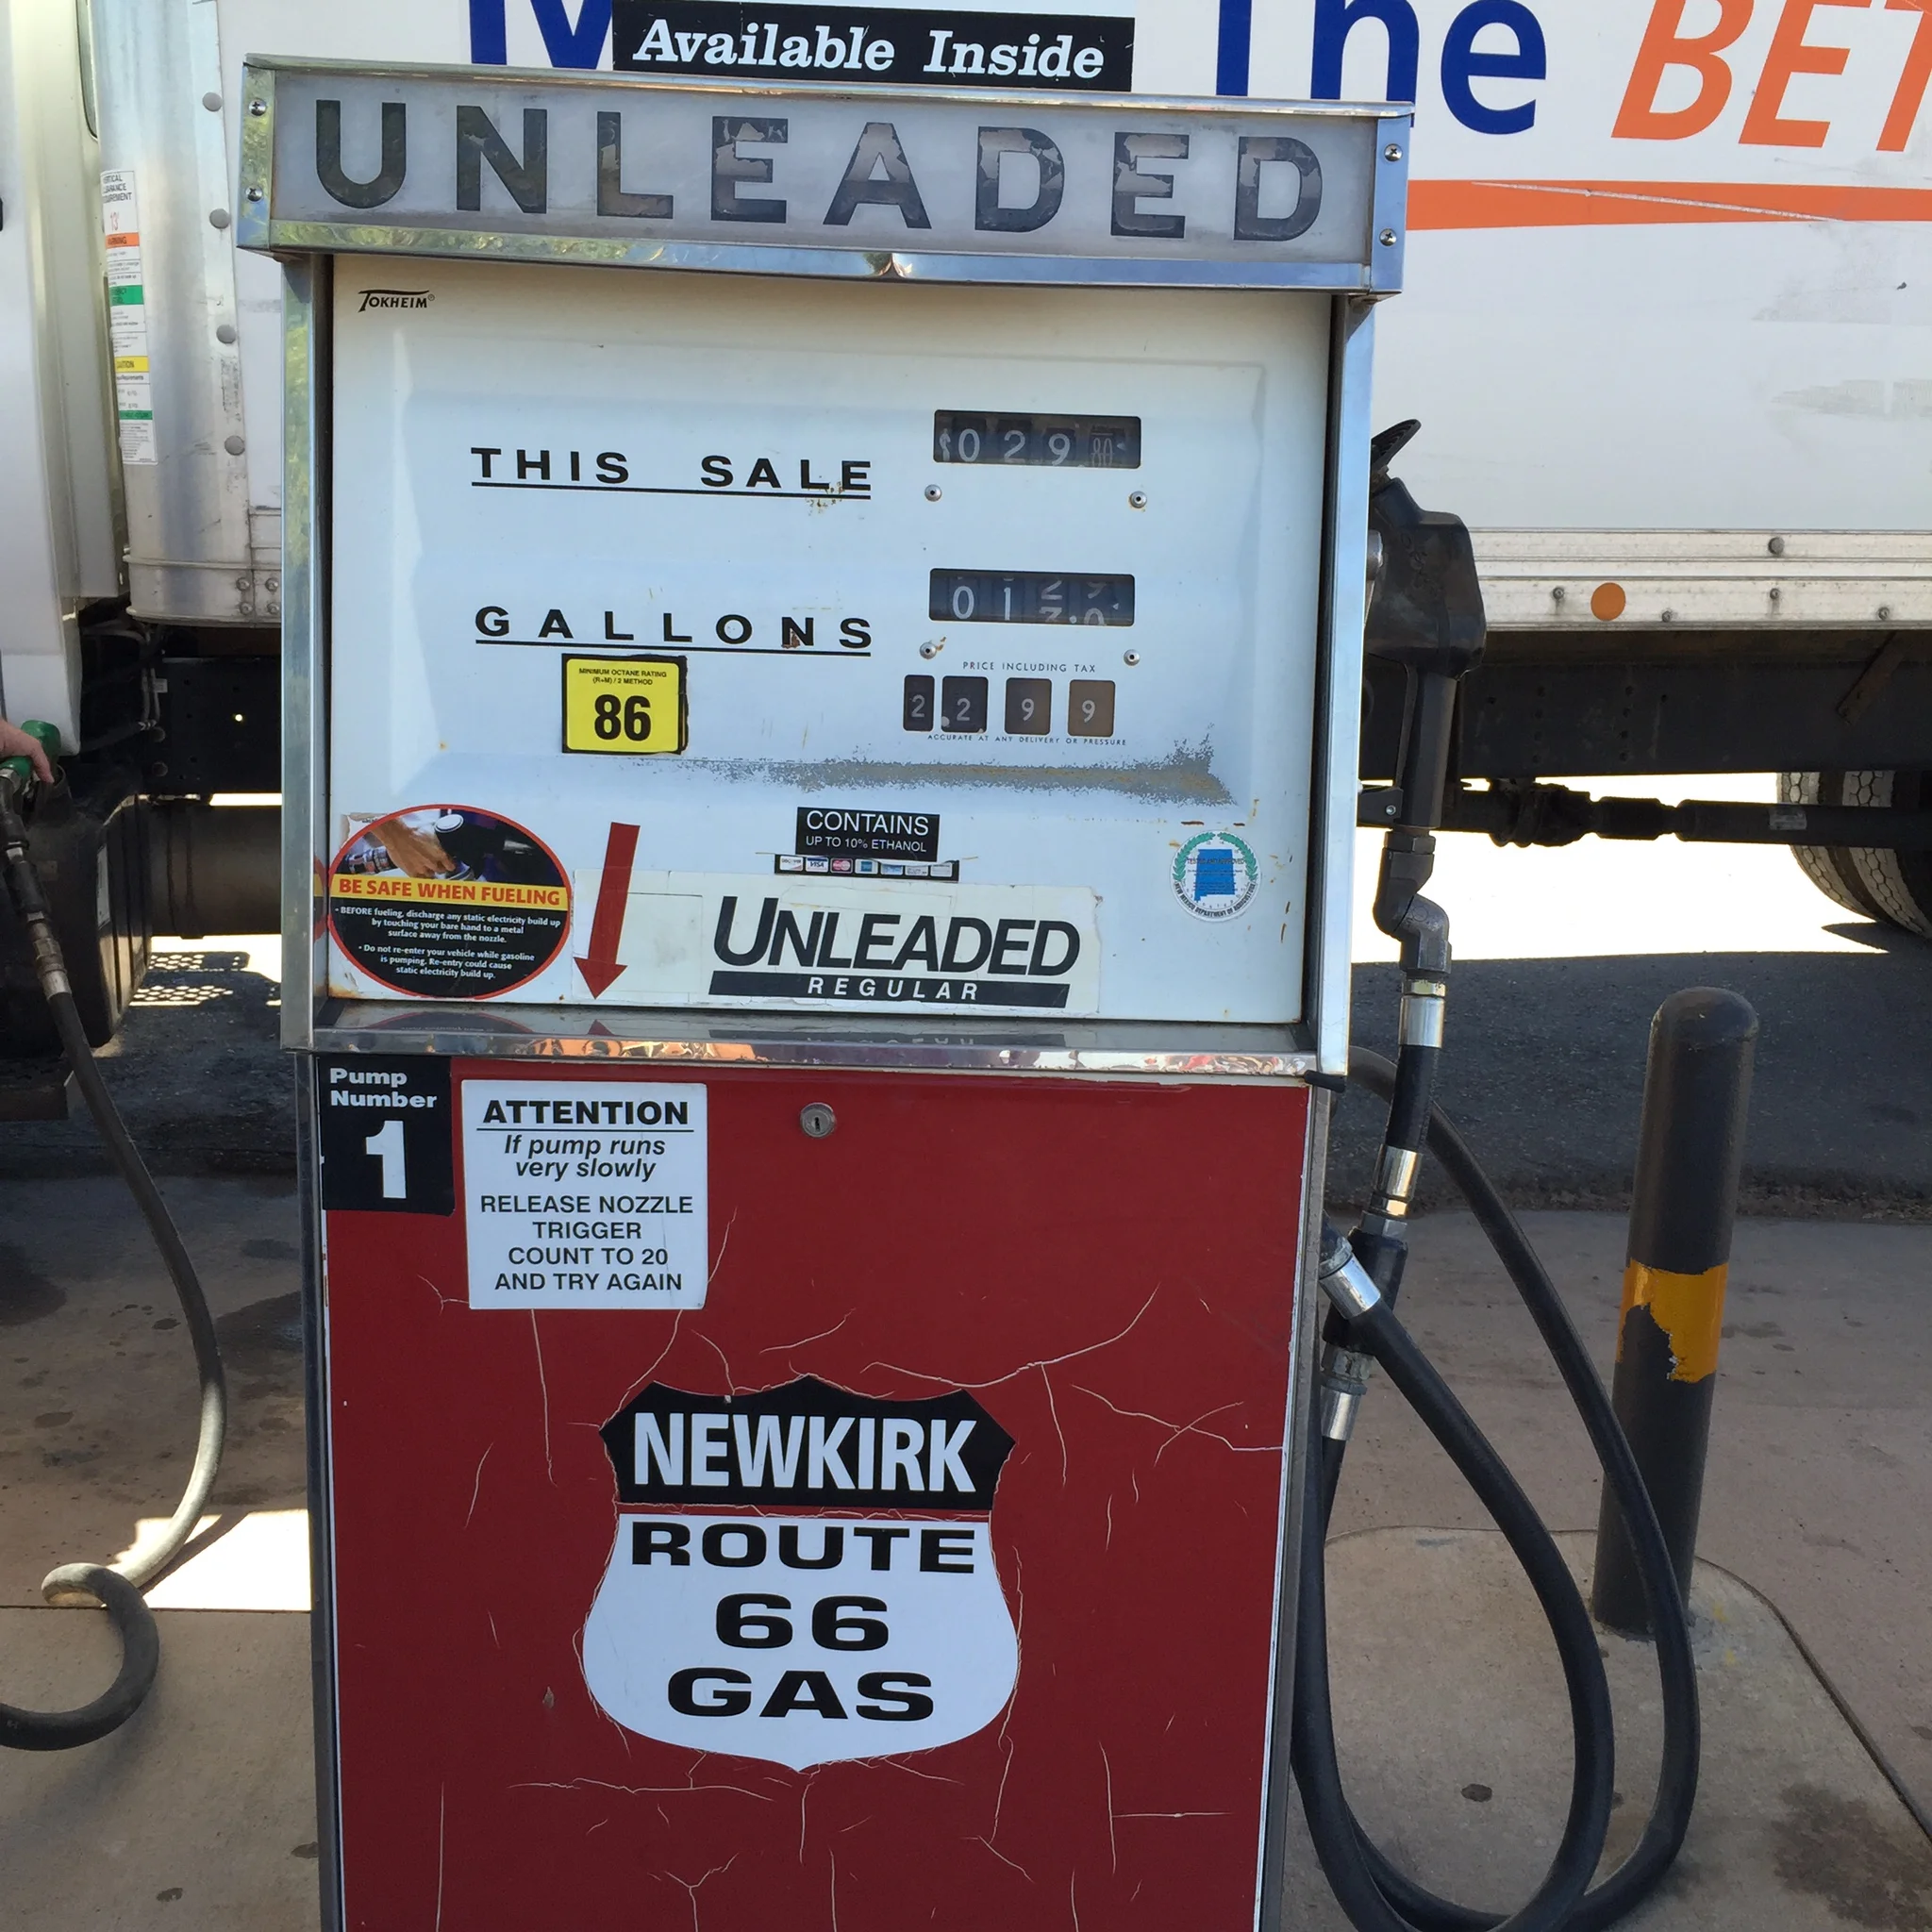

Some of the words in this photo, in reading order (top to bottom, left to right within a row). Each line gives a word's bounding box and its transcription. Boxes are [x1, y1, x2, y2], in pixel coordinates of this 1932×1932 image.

[632, 18, 894, 72] Available
[923, 29, 1106, 78] Inside
[316, 99, 1324, 242] UNLEADED
[471, 447, 629, 484] THIS
[701, 454, 871, 491] SALE
[475, 606, 873, 649] GALLONS
[963, 661, 994, 671] PRICE
[1002, 662, 1067, 673] INCLUDING
[1074, 664, 1096, 673] TAX
[594, 693, 652, 742] 86
[807, 810, 929, 837] CONTAINS
[806, 836, 823, 846] UP
[824, 837, 841, 847] TO
[844, 838, 868, 849] 10%
[871, 839, 927, 852] ETHANOL
[339, 878, 363, 894] BE
[366, 879, 412, 897] SAFE
[417, 882, 475, 901] WHEN
[481, 886, 560, 907] FUELING
[341, 907, 373, 916] BEFORE
[406, 909, 445, 921] discharge
[446, 913, 462, 923] any
[463, 913, 485, 923] static
[487, 914, 526, 925] electricity
[527, 916, 549, 926] build
[550, 920, 561, 928] up
[372, 918, 383, 927] by
[383, 919, 420, 930] touching
[420, 922, 439, 931] your
[440, 921, 459, 930] bare
[460, 923, 482, 932] hand
[500, 925, 525, 934] metal
[388, 928, 418, 938] surface
[419, 931, 441, 941] away
[441, 931, 462, 941] from
[463, 933, 477, 941] the
[478, 934, 507, 943] nozzle.
[713, 895, 1081, 977] UNLEADED
[389, 956, 427, 967] pumping.
[428, 958, 463, 968] Re-entry
[464, 959, 488, 969] could
[392, 946, 425, 955] re-enter
[446, 949, 475, 958] vehicle
[476, 950, 500, 959] while
[500, 952, 535, 961] gasoline
[395, 966, 418, 974] static
[419, 967, 459, 978] electricity
[460, 969, 482, 978] build
[807, 975, 979, 1001] REGULAR
[329, 1067, 408, 1088] Pump
[330, 1089, 438, 1109] Number
[482, 1099, 690, 1125] ATTENTION
[365, 1119, 407, 1199] 1
[504, 1134, 521, 1155] If
[527, 1136, 601, 1160] pump
[608, 1139, 666, 1156] runs
[515, 1160, 569, 1183] very
[576, 1158, 657, 1183] slowly
[480, 1195, 591, 1213] RELEASE
[599, 1195, 693, 1214] NOZZLE
[532, 1221, 641, 1240] TRIGGER
[508, 1246, 594, 1265] COUNT
[601, 1247, 634, 1266] TO
[641, 1247, 669, 1266] 20
[494, 1273, 547, 1291] AND
[553, 1273, 600, 1291] TRY
[606, 1273, 683, 1291] AGAIN
[634, 1411, 978, 1493] NEWKIRK
[632, 1521, 975, 1574] ROUTE
[715, 1592, 890, 1652] 66
[667, 1666, 935, 1722] GAS
